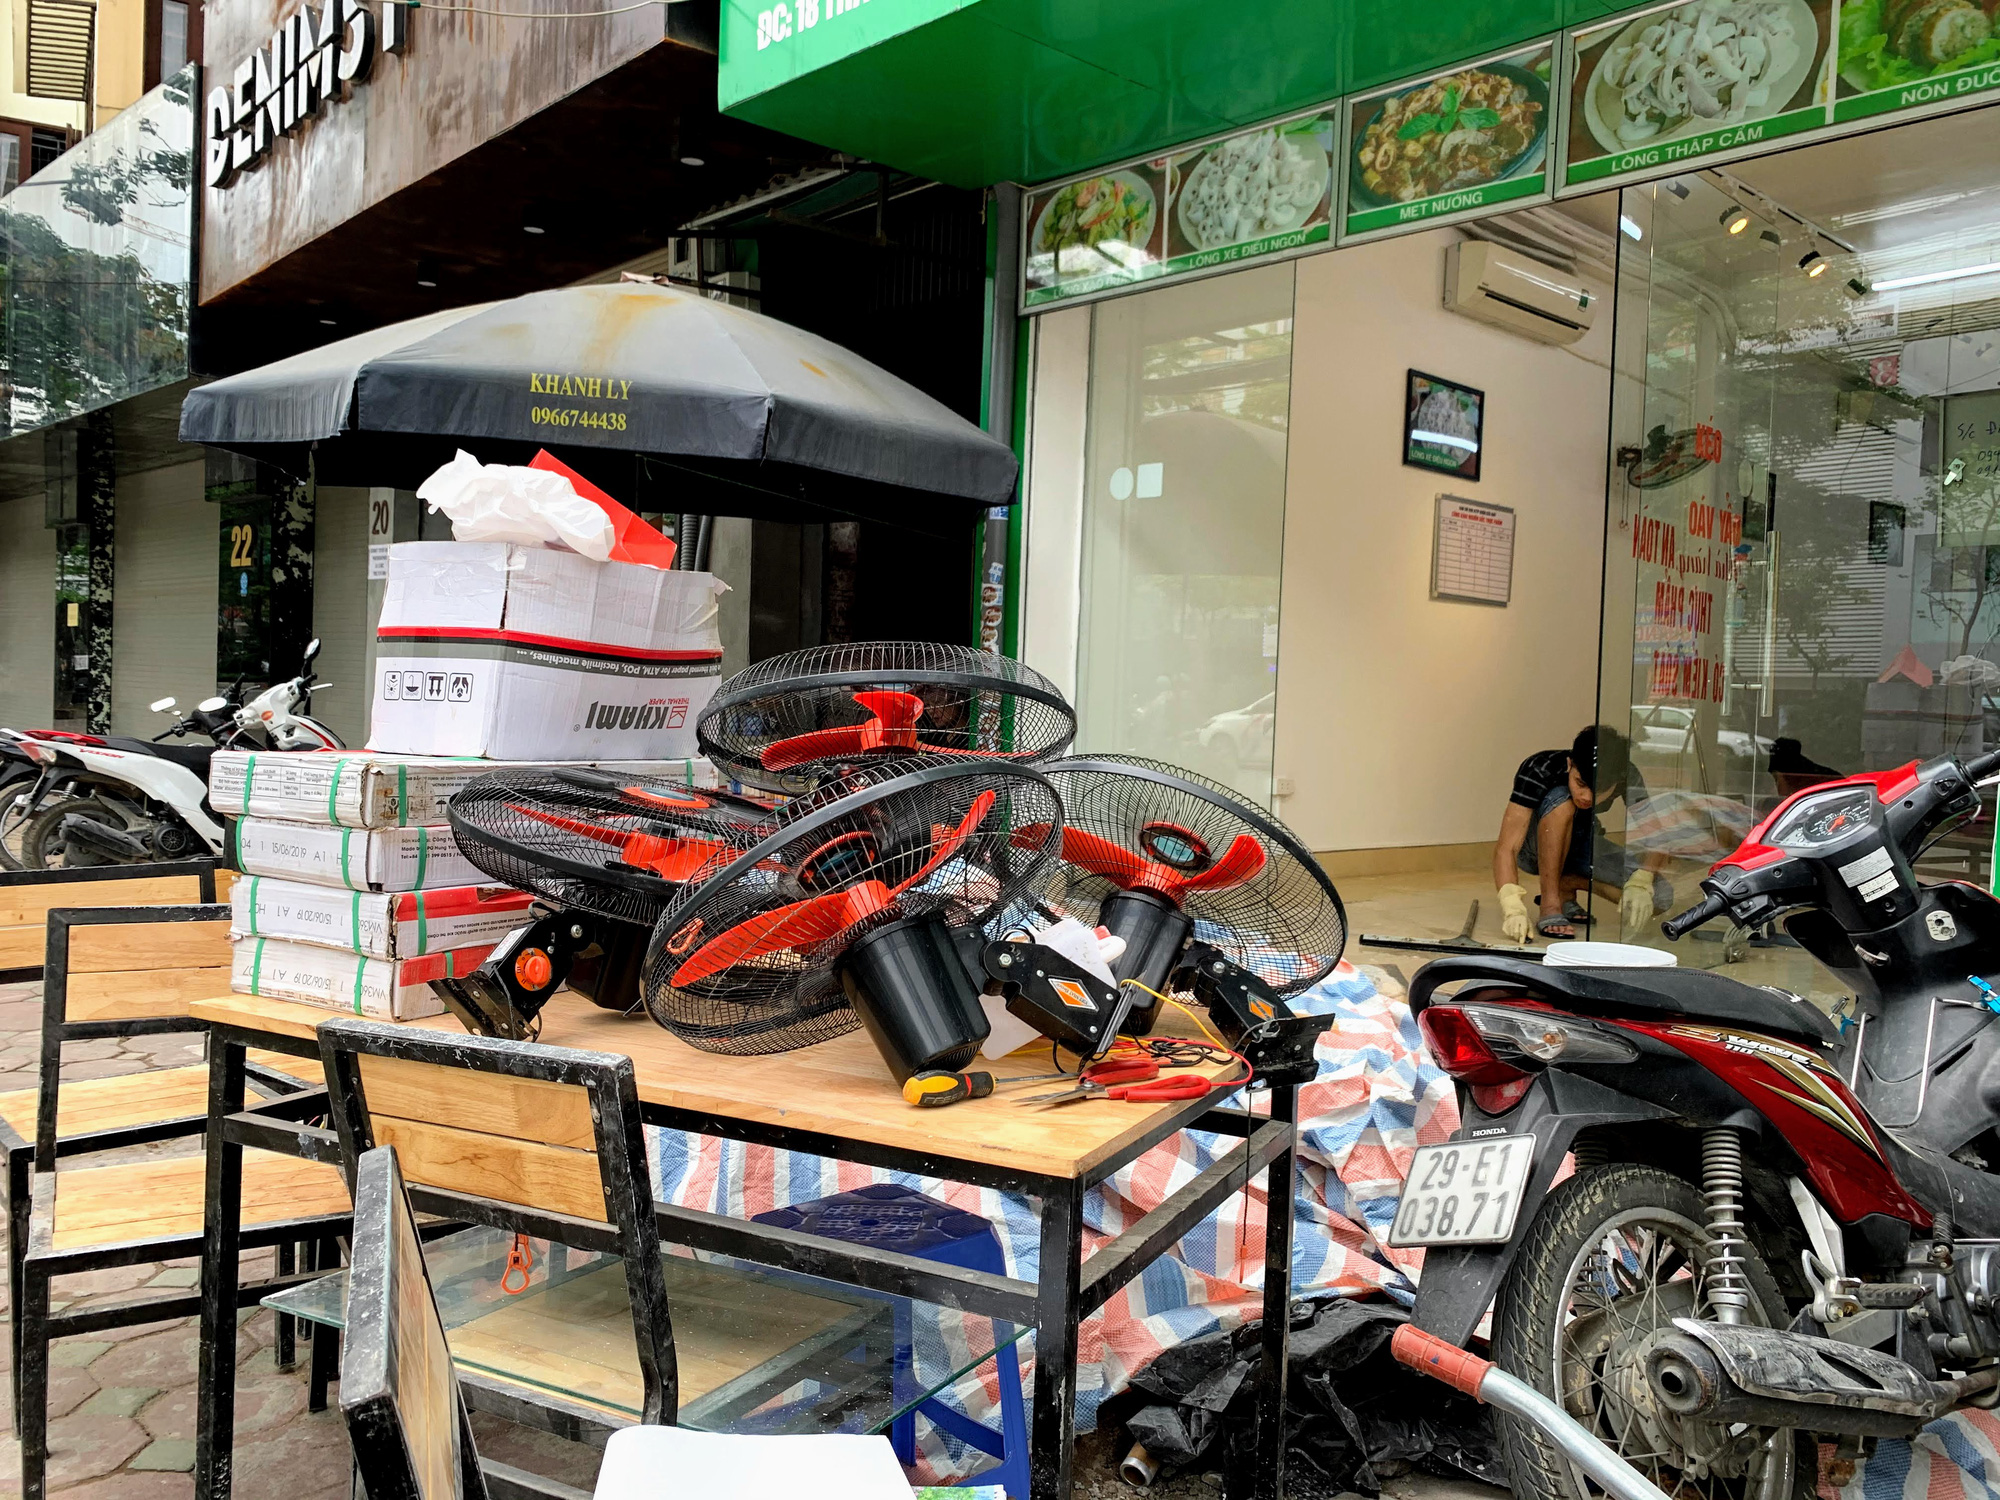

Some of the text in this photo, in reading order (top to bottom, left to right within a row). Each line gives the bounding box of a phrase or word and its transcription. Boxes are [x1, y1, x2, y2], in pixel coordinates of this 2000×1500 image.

[1611, 150, 1659, 173] LÒNG
[1666, 137, 1716, 162] THẬP
[1270, 233, 1307, 251] NGON
[530, 372, 602, 398] KHÁNH
[531, 406, 628, 432] 0966744438
[372, 500, 389, 535] 20
[230, 524, 252, 567] 22
[581, 659, 620, 673] facsimile
[660, 666, 671, 676] for
[272, 842, 306, 858] 15/06/2019
[313, 852, 326, 863] A1
[277, 906, 290, 918] A1
[297, 909, 332, 926] 15/06/2019
[272, 968, 287, 980] A1
[294, 972, 331, 990] 15/06/2019
[1724, 1043, 1755, 1055] 110
[1472, 1127, 1507, 1137] HONDA
[1420, 1143, 1513, 1192] 29-E1
[1398, 1190, 1510, 1239] 038.71
